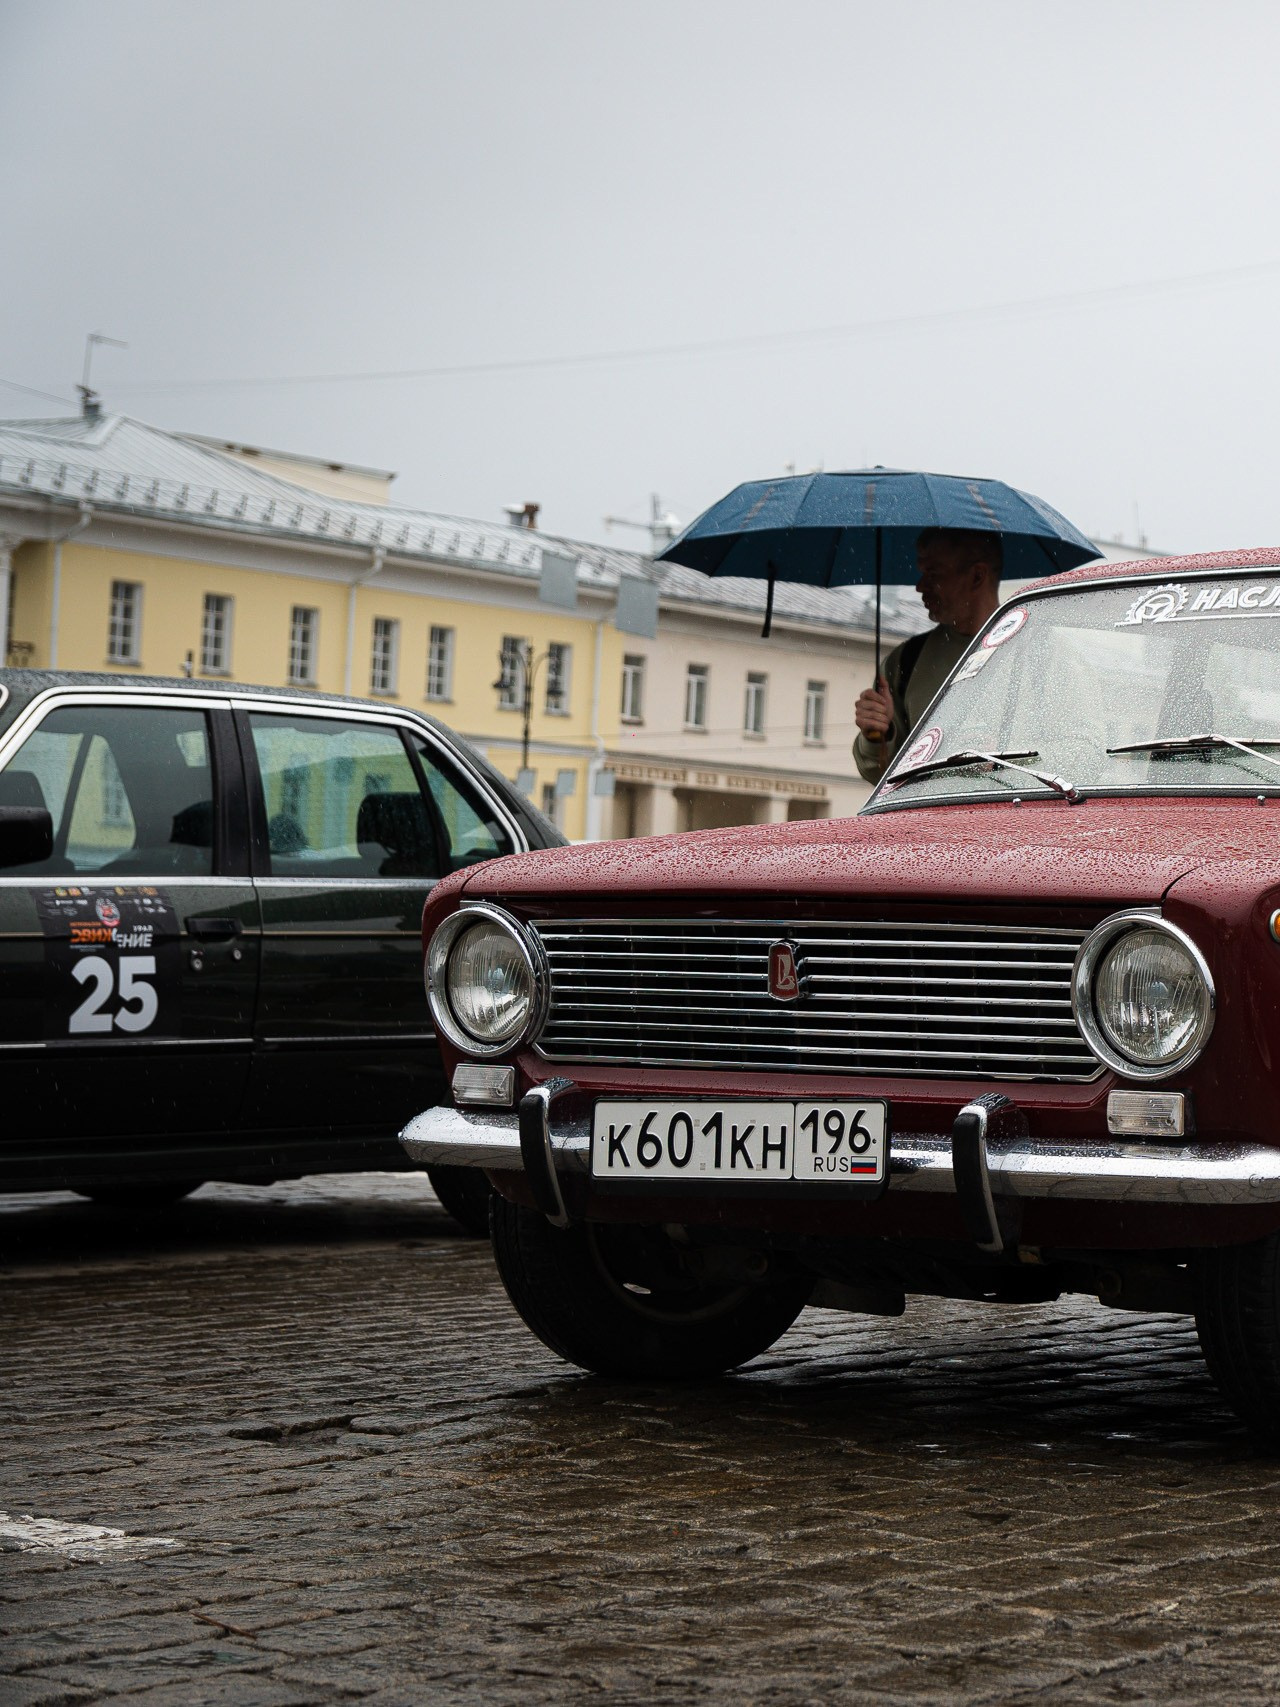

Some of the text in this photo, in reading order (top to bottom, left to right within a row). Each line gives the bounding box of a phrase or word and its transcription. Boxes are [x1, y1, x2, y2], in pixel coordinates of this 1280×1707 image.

[69, 955, 159, 1034] 25
[607, 1108, 872, 1170] К601КН 196
[813, 1156, 849, 1173] RUS
